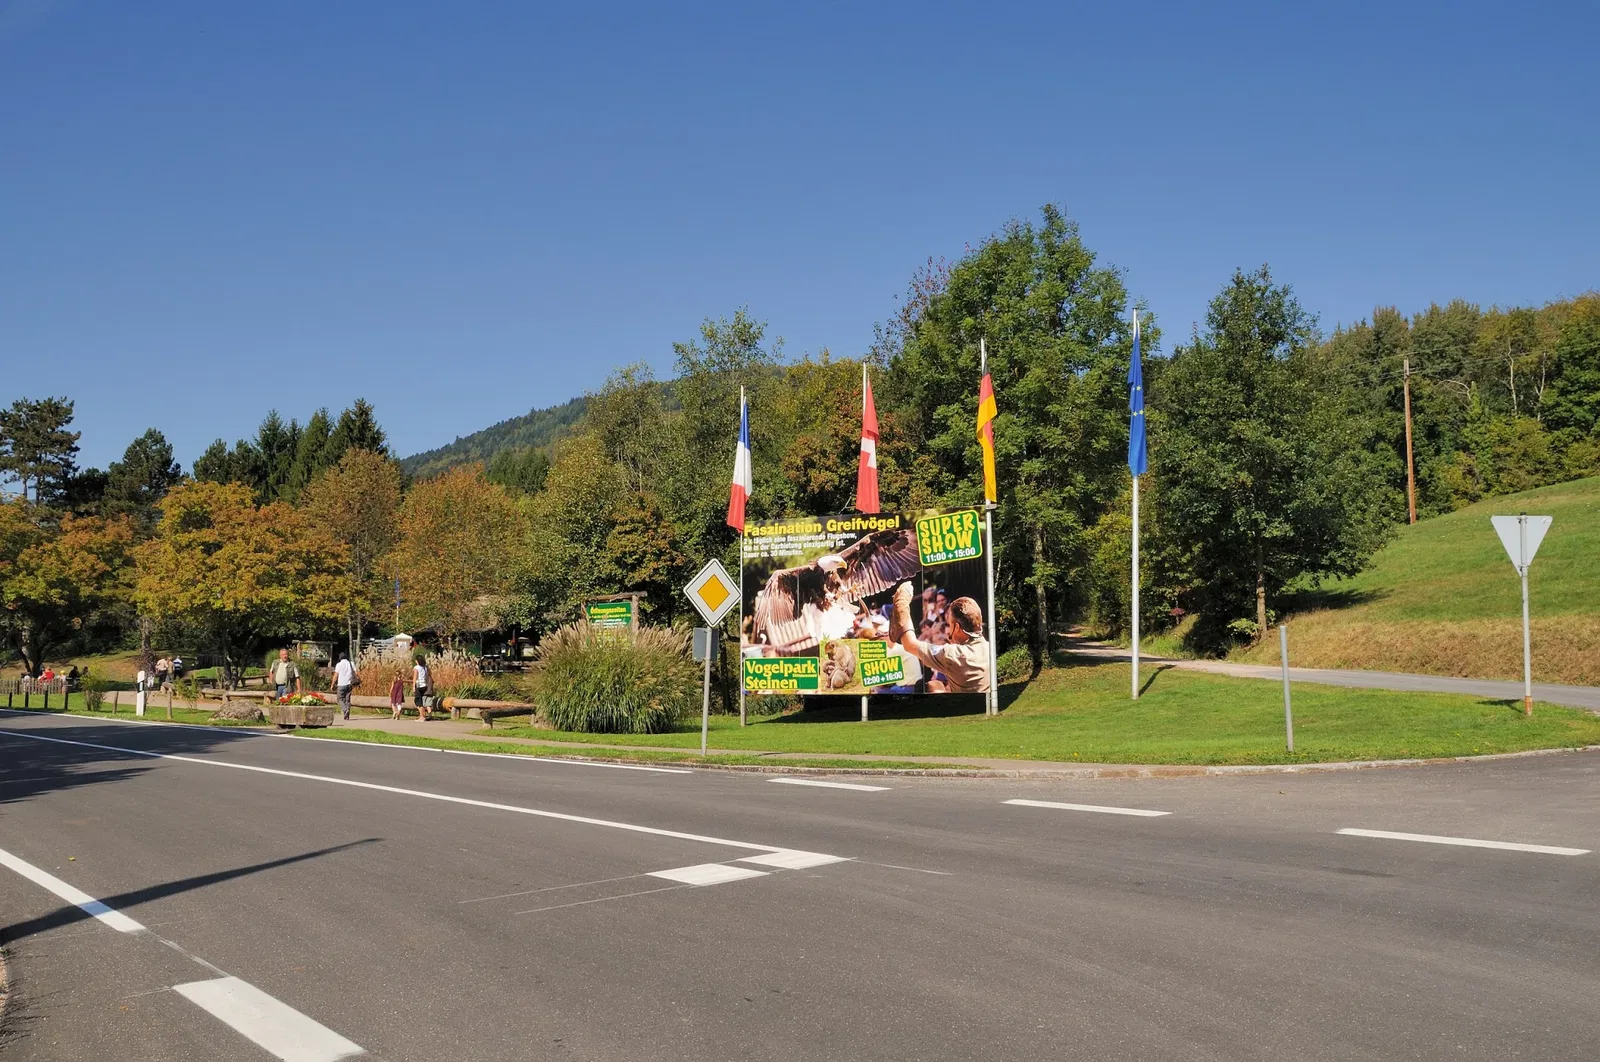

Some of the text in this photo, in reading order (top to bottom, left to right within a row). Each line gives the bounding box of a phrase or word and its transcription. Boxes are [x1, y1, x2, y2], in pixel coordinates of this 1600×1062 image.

[744, 515, 900, 537] Faszination Greifvögel
[919, 513, 975, 538] SUPER
[827, 532, 857, 541] Flugshow,
[921, 530, 973, 555] SHOW
[926, 551, 947, 563] 11:00
[954, 547, 976, 559] 15:00
[745, 660, 817, 677] Vogelpark
[863, 657, 899, 676] SHOW
[745, 675, 798, 689] Steinen
[864, 675, 880, 685] 12:00
[885, 671, 902, 682] 16:00
